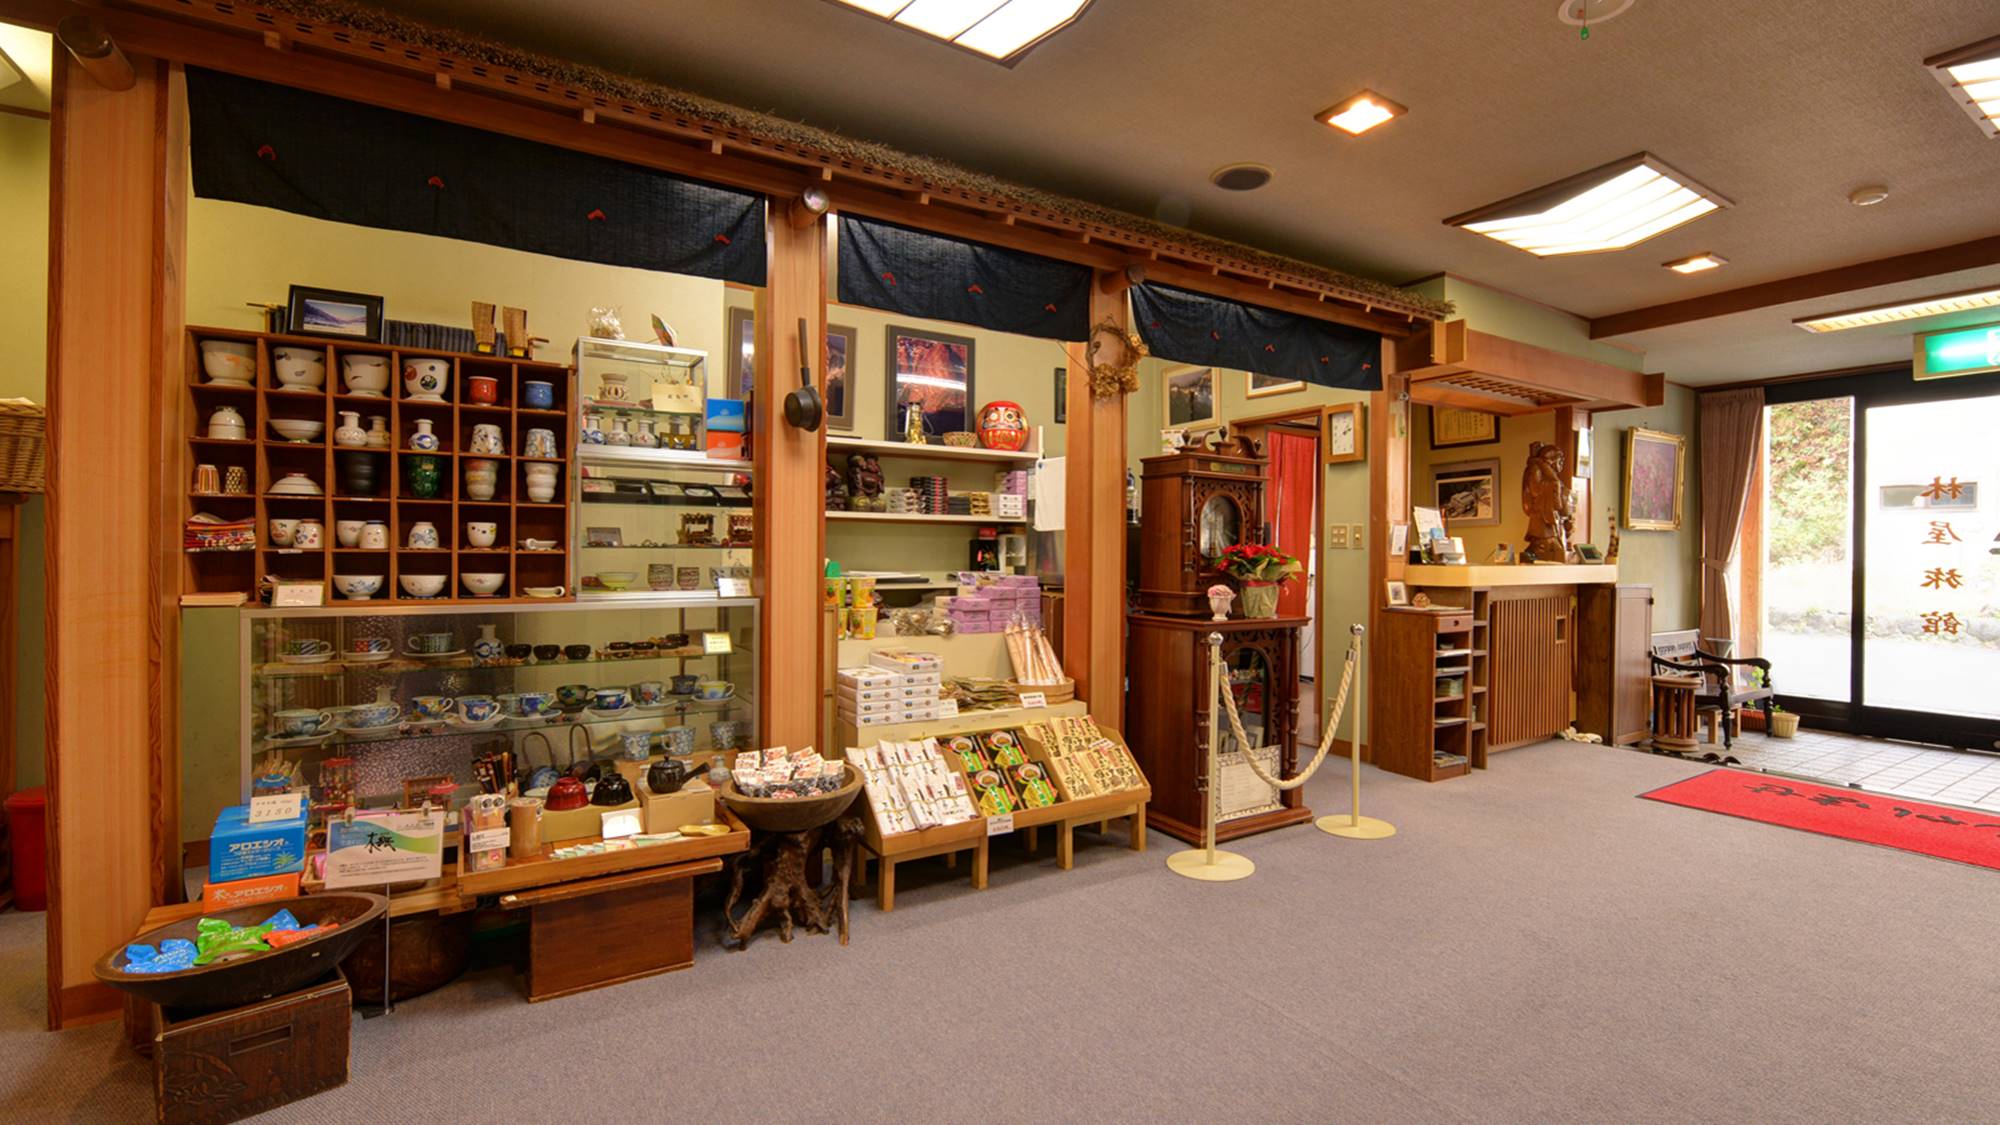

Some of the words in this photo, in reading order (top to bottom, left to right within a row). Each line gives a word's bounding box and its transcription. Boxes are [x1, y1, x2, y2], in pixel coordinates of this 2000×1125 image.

[229, 838, 285, 852] アロエシオ
